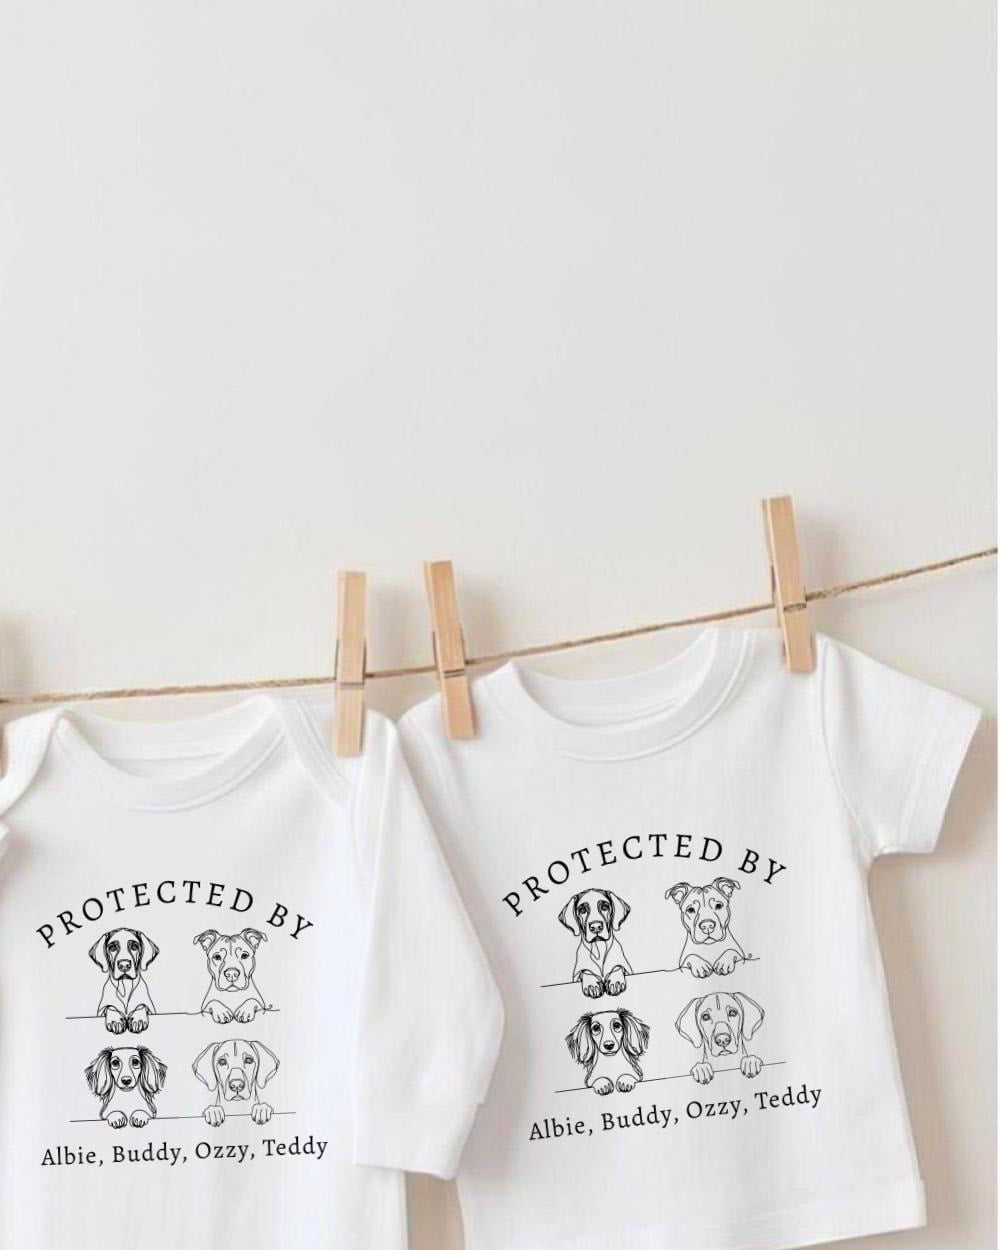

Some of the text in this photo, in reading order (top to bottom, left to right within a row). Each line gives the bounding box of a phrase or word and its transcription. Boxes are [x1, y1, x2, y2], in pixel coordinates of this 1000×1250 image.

[502, 834, 786, 917] PROTECTED BY
[36, 880, 313, 949] PROTECTED BY
[529, 1084, 821, 1141] Albie, Buddy, Ozzy, Teddy
[41, 1136, 328, 1166] Albie, Buddy, Ozzy, Teddy
